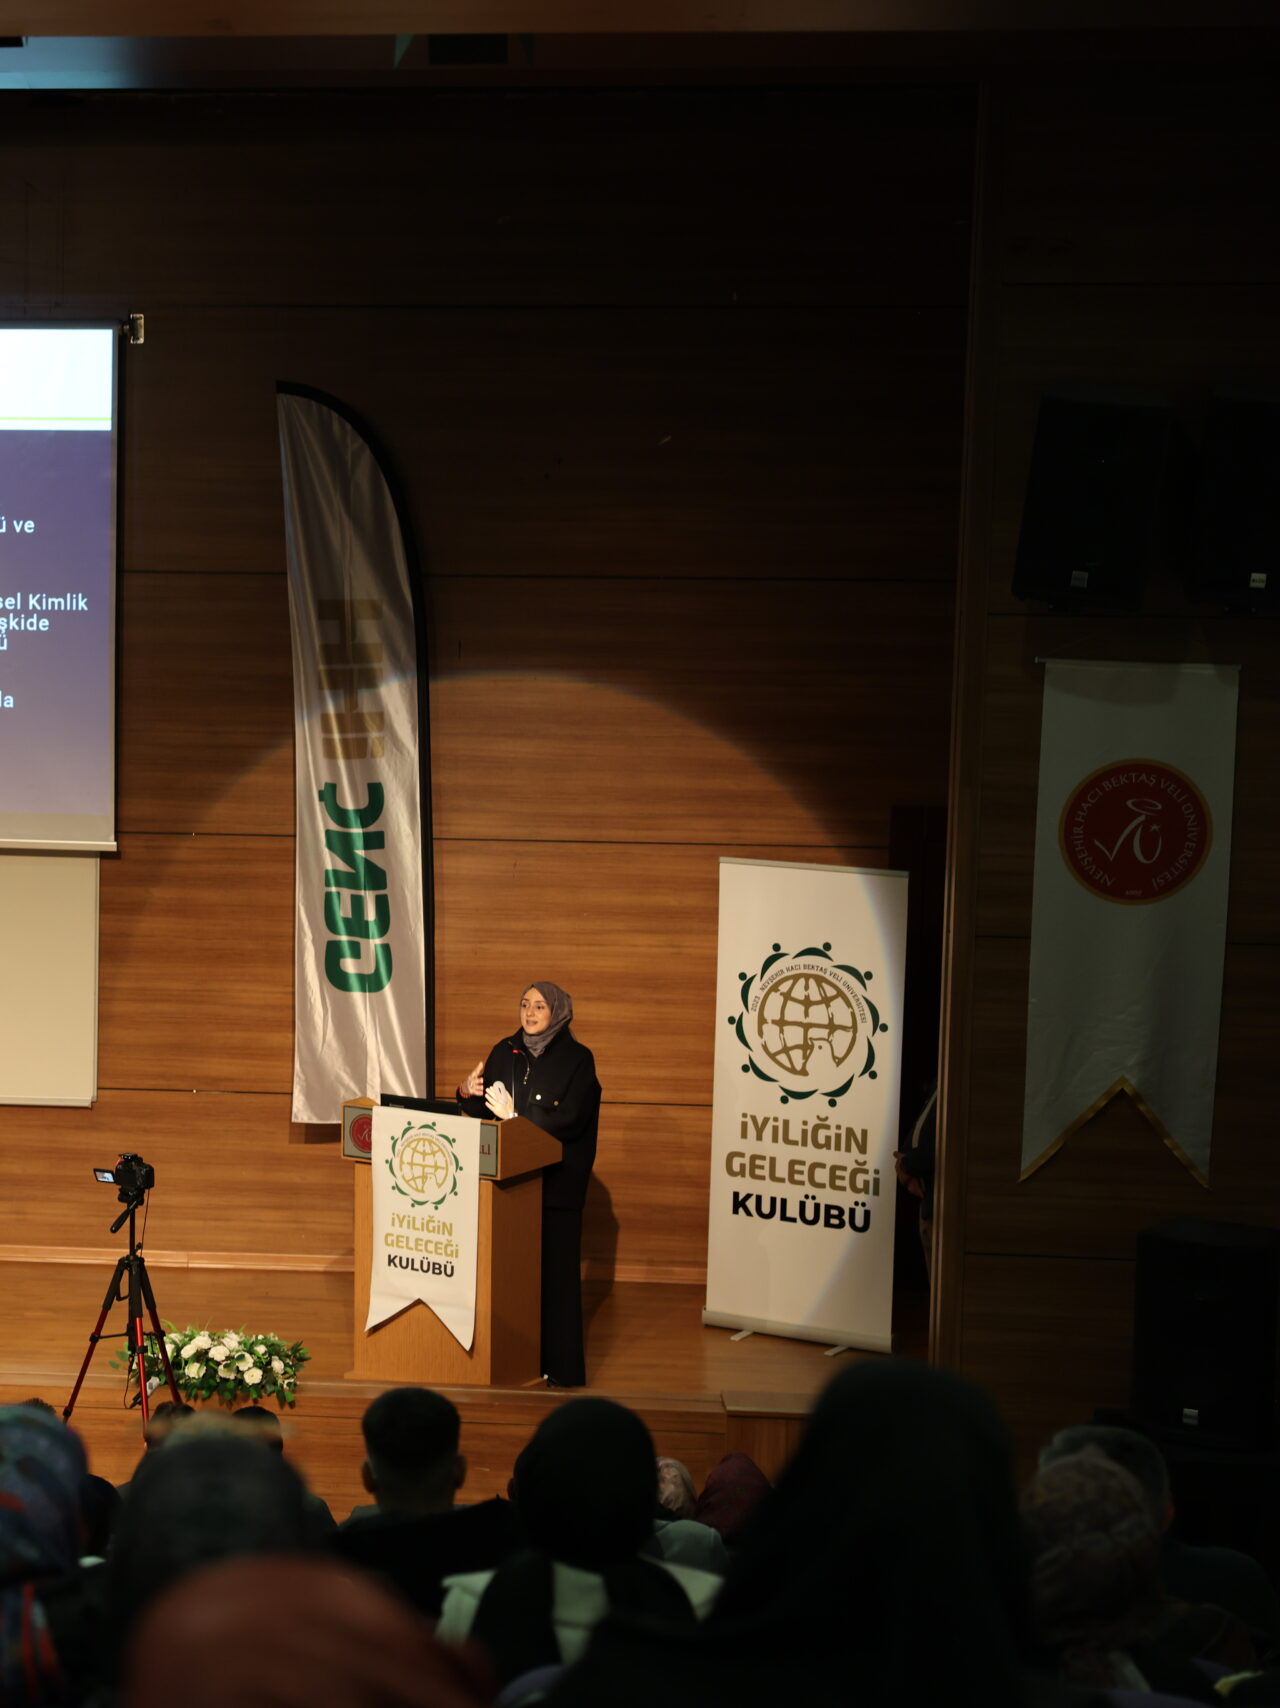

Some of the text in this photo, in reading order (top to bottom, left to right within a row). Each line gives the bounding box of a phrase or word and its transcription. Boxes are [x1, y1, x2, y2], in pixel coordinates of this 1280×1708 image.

[13, 519, 35, 533] ve
[28, 592, 88, 611] Kimlik
[732, 1191, 871, 1233] KULÜBÜ
[387, 1254, 455, 1278] KULÜBÜ
